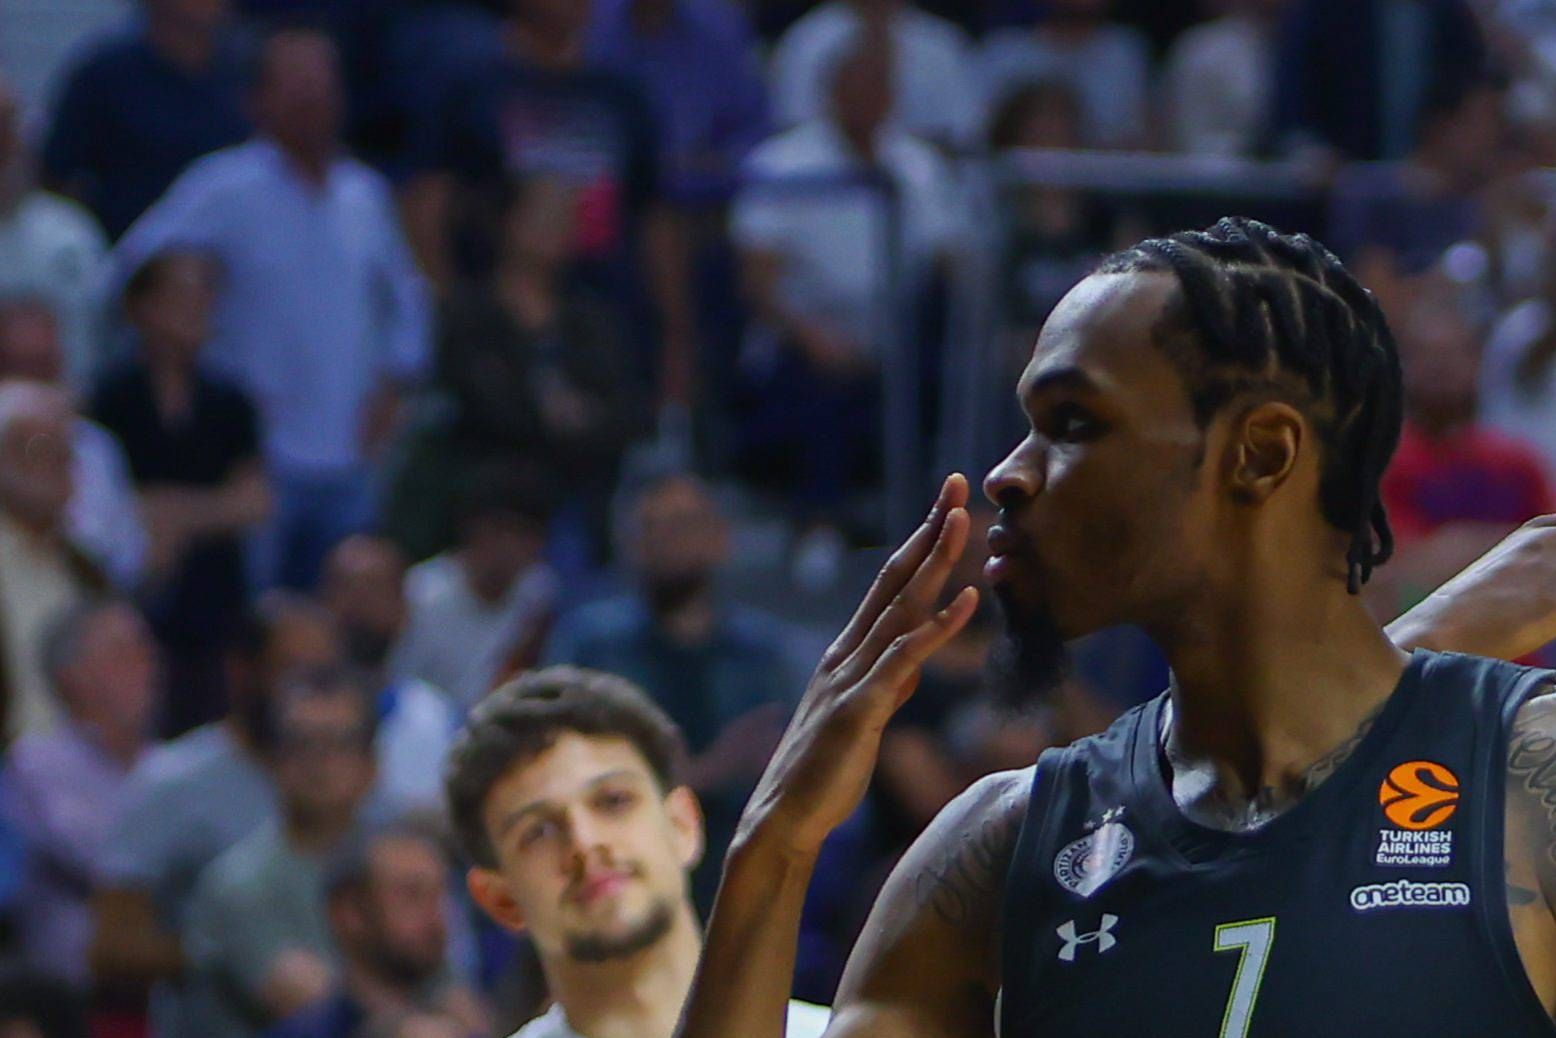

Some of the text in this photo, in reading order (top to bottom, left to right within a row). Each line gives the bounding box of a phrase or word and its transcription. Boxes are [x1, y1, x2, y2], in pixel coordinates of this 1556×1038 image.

[1380, 829, 1452, 842] TURKISH
[1377, 842, 1451, 854] AIRLINES
[1376, 853, 1450, 866] EuroLeague
[1351, 879, 1470, 909] oneteam
